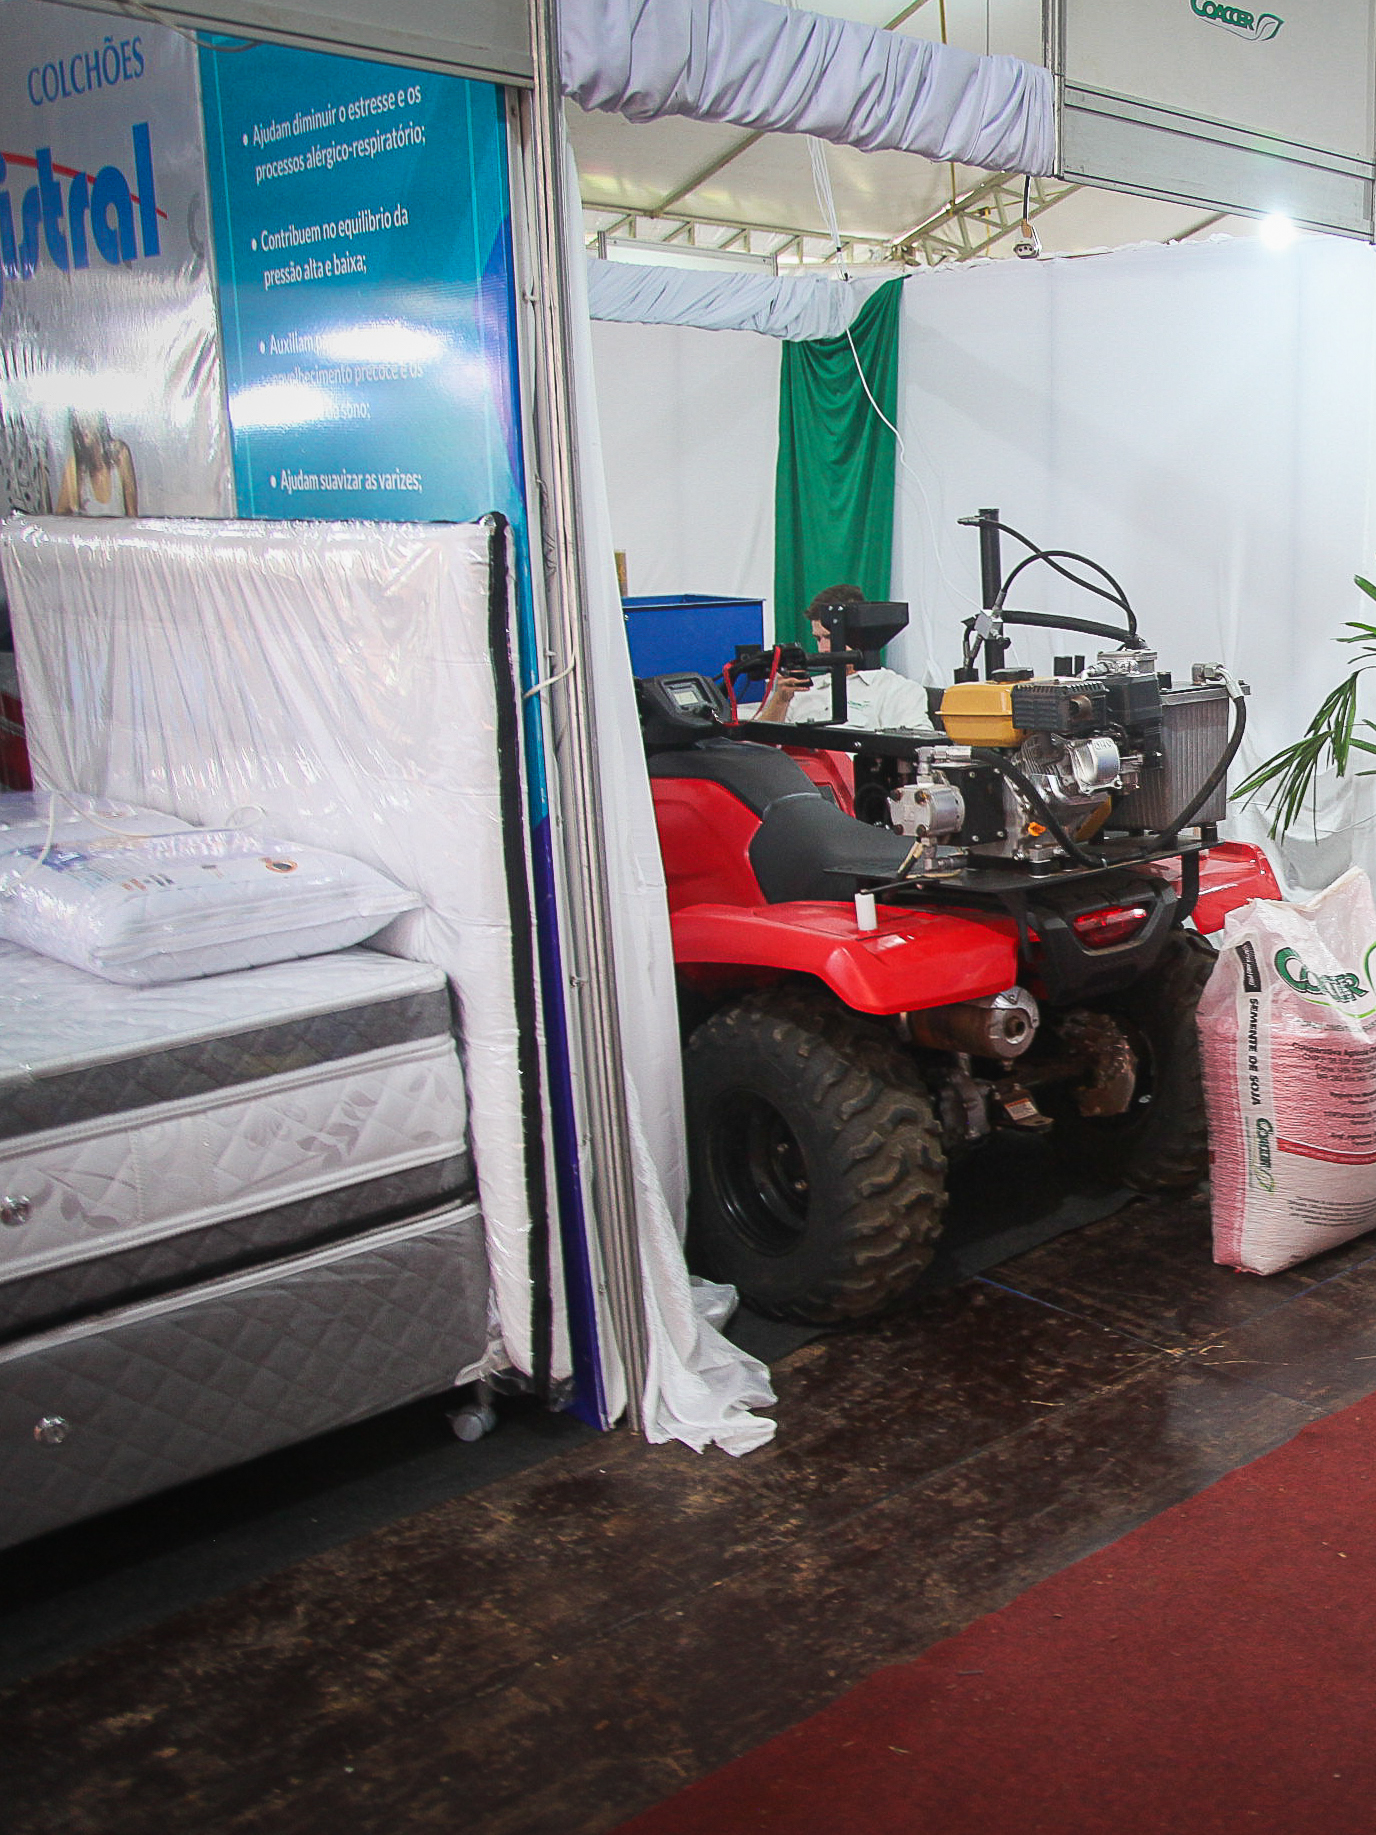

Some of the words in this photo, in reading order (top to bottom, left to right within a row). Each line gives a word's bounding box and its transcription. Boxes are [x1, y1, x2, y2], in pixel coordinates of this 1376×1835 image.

[27, 35, 145, 106] COLCHÕES
[253, 119, 291, 149] Ajudam
[293, 103, 336, 135] diminuir
[339, 105, 346, 123] o
[349, 92, 395, 121] estresse
[397, 89, 405, 108] e
[407, 85, 422, 105] os
[255, 153, 305, 187] processos
[306, 121, 427, 170] alérgico-respiratório;
[261, 225, 321, 251] Contribuem
[323, 222, 337, 240] no
[393, 203, 409, 227] da
[263, 261, 302, 291] pressão
[303, 257, 324, 281] alta
[325, 260, 332, 277] e
[333, 251, 367, 275] baixa;
[270, 331, 314, 355] Auxiliam
[280, 468, 319, 495] Ajudam
[320, 468, 363, 491] suavizar
[364, 473, 377, 491] as
[378, 467, 423, 494] varizes;
[1248, 998, 1259, 1052] SEMENTE
[1249, 1055, 1259, 1072] DE
[1249, 1075, 1263, 1106] SOJA
